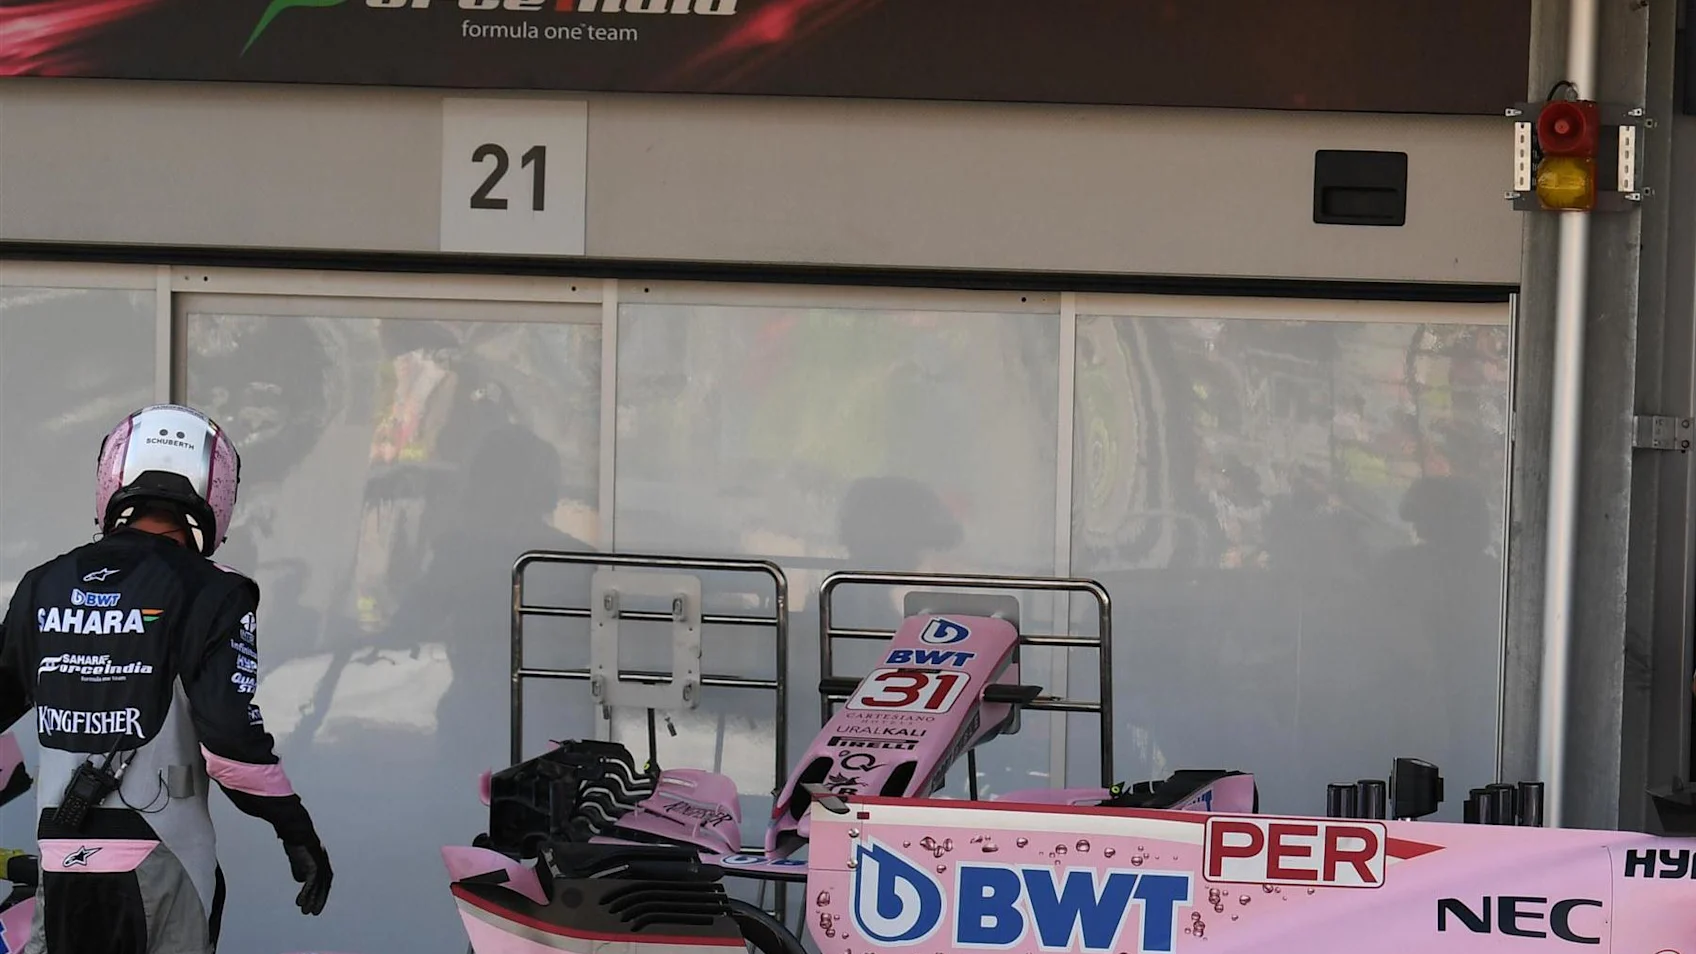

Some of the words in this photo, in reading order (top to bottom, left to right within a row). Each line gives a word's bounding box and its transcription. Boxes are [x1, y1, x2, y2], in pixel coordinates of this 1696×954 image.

[461, 20, 539, 40] formula
[588, 24, 638, 42] team
[469, 143, 548, 212] 21
[146, 437, 195, 450] SCHUBERTH
[85, 592, 121, 607] BWT
[37, 607, 145, 634] SAHARA
[886, 650, 976, 667] BWT
[861, 671, 959, 710] 31
[846, 712, 936, 722] CARTESIANO
[836, 725, 927, 737] URALKALI
[827, 736, 919, 750] PIRELLI
[1208, 820, 1379, 884] PER
[1437, 895, 1603, 945] NEC
